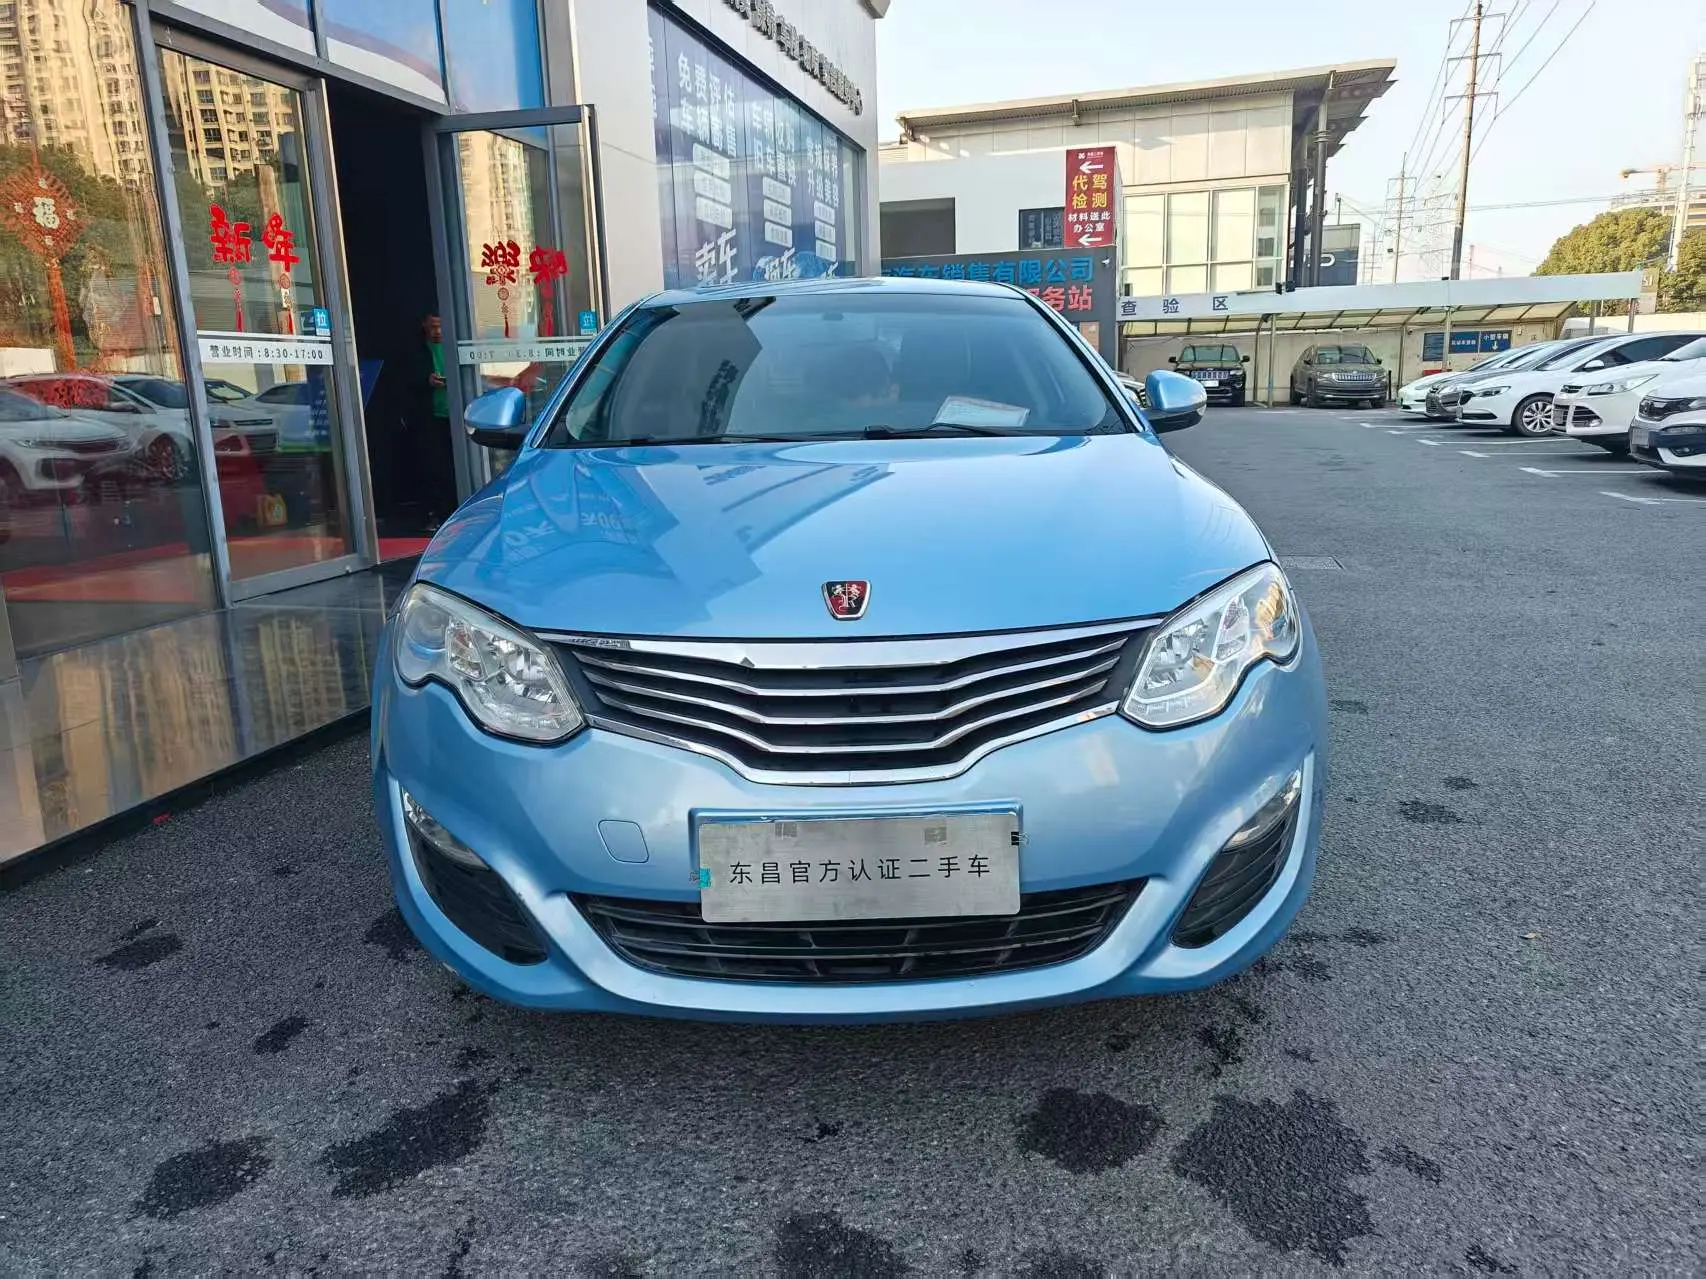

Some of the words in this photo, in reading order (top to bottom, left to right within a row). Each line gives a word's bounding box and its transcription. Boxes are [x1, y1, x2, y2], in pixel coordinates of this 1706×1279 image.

[678, 52, 736, 119] 免费评估
[1072, 173, 1108, 191] 代驾
[1072, 192, 1108, 209] 检测
[33, 197, 60, 229] 福
[1068, 211, 1111, 222] 材料送此
[208, 203, 300, 272] 新年
[1073, 222, 1105, 233] 办公室
[1028, 284, 1093, 311] 务站
[1121, 295, 1229, 317] 查验区
[730, 854, 990, 885] 东昌官方认证二手车
